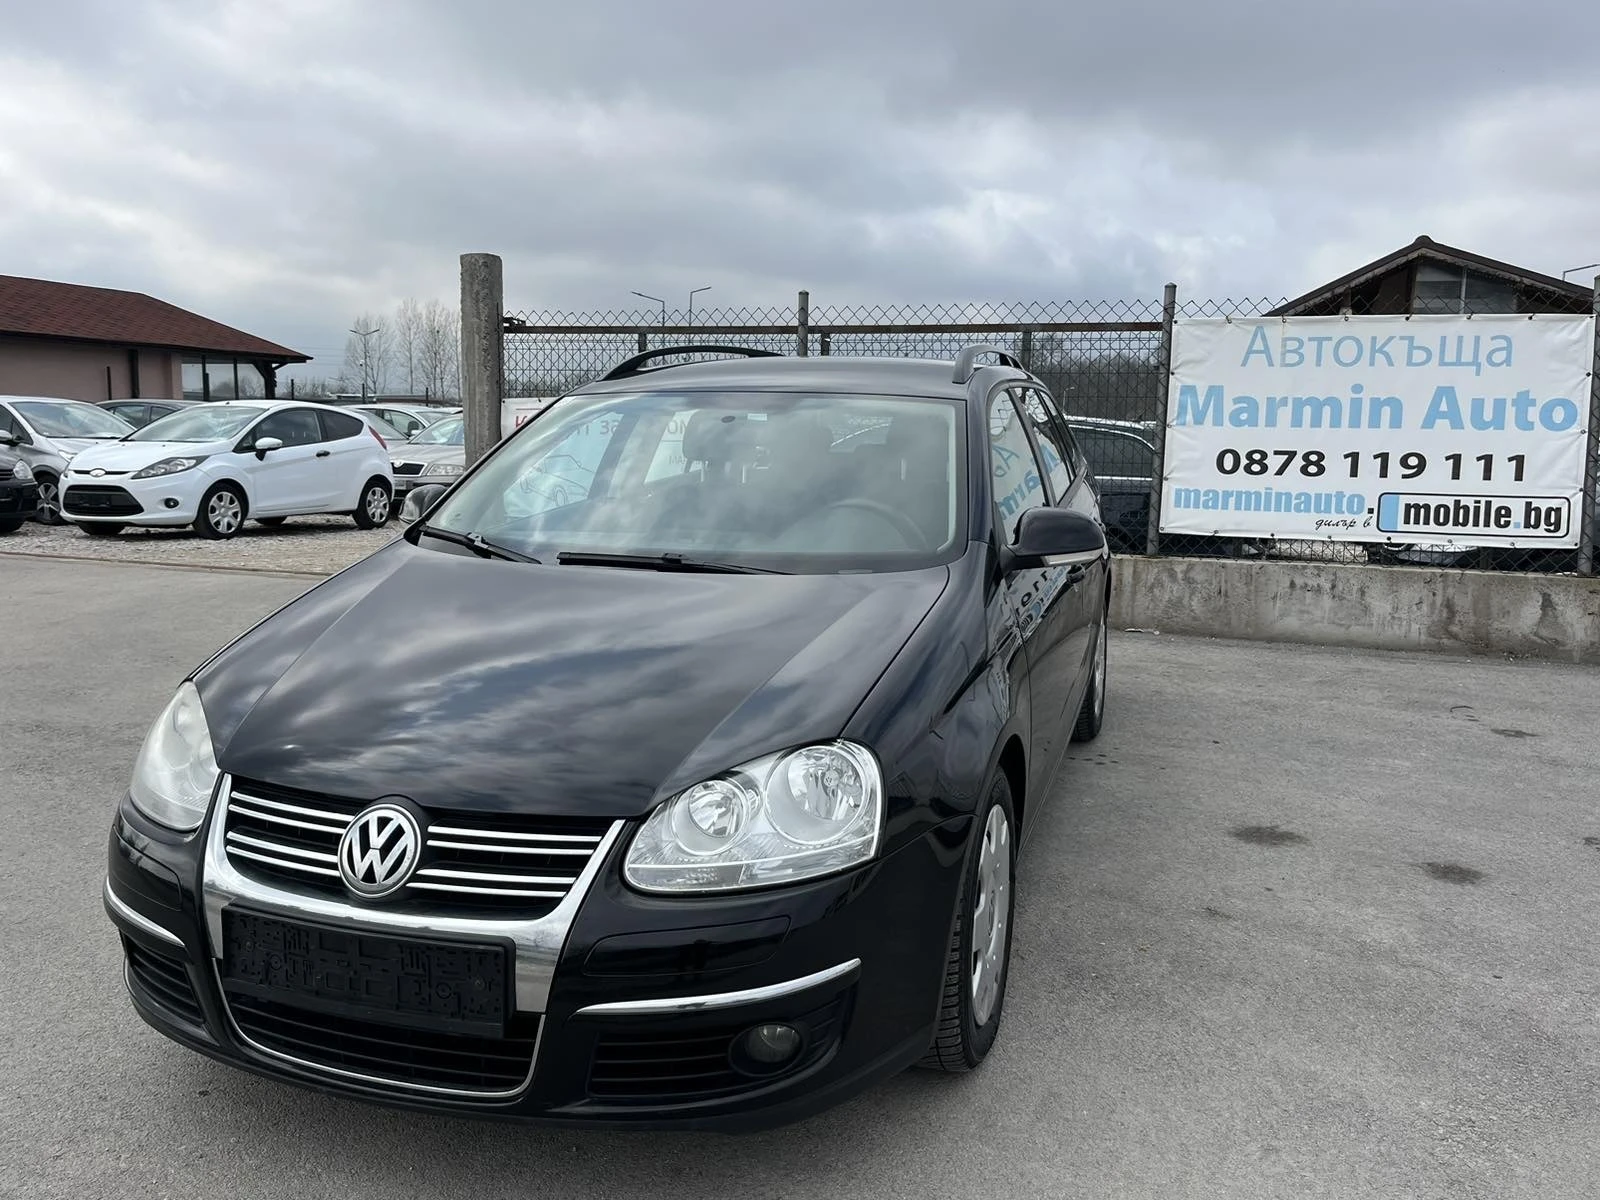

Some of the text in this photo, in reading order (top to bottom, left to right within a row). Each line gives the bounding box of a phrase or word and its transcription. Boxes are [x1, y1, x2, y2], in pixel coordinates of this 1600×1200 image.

[1240, 325, 1514, 377] Автокъща
[1175, 383, 1580, 432] Marmin Auto
[1215, 448, 1527, 483] 0878 119 111
[1403, 499, 1563, 534] mobile.bg
[338, 803, 422, 898] VW
